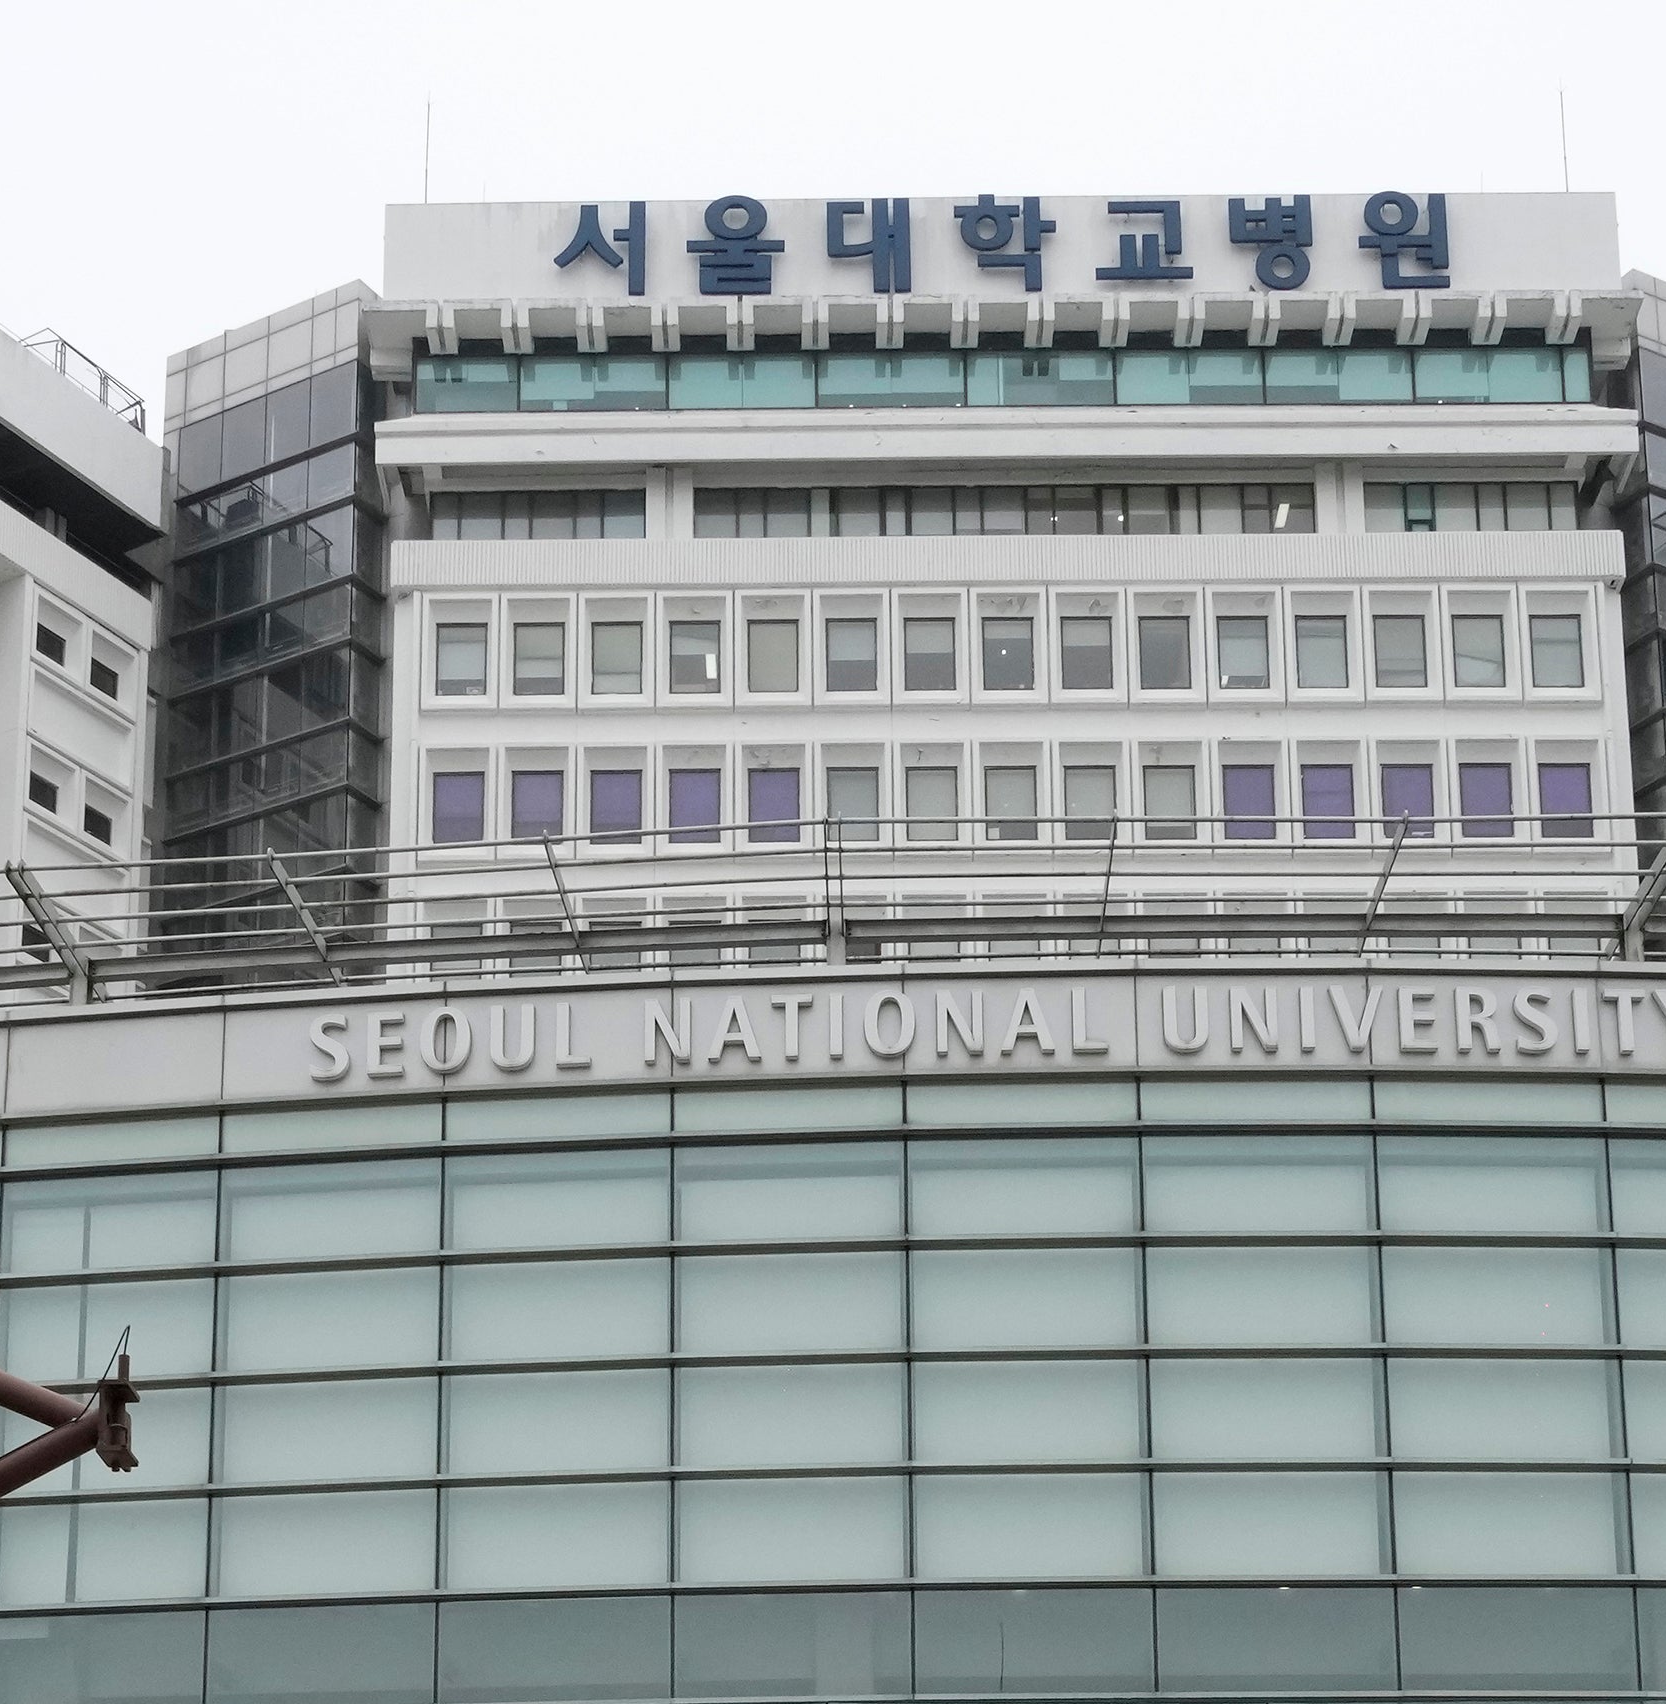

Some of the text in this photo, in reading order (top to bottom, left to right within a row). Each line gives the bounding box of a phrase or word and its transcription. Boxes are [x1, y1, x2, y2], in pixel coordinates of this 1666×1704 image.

[553, 190, 1452, 297] 서울대학교병원
[308, 1001, 593, 1083] SEOUL
[641, 985, 1111, 1066] NATIONAL
